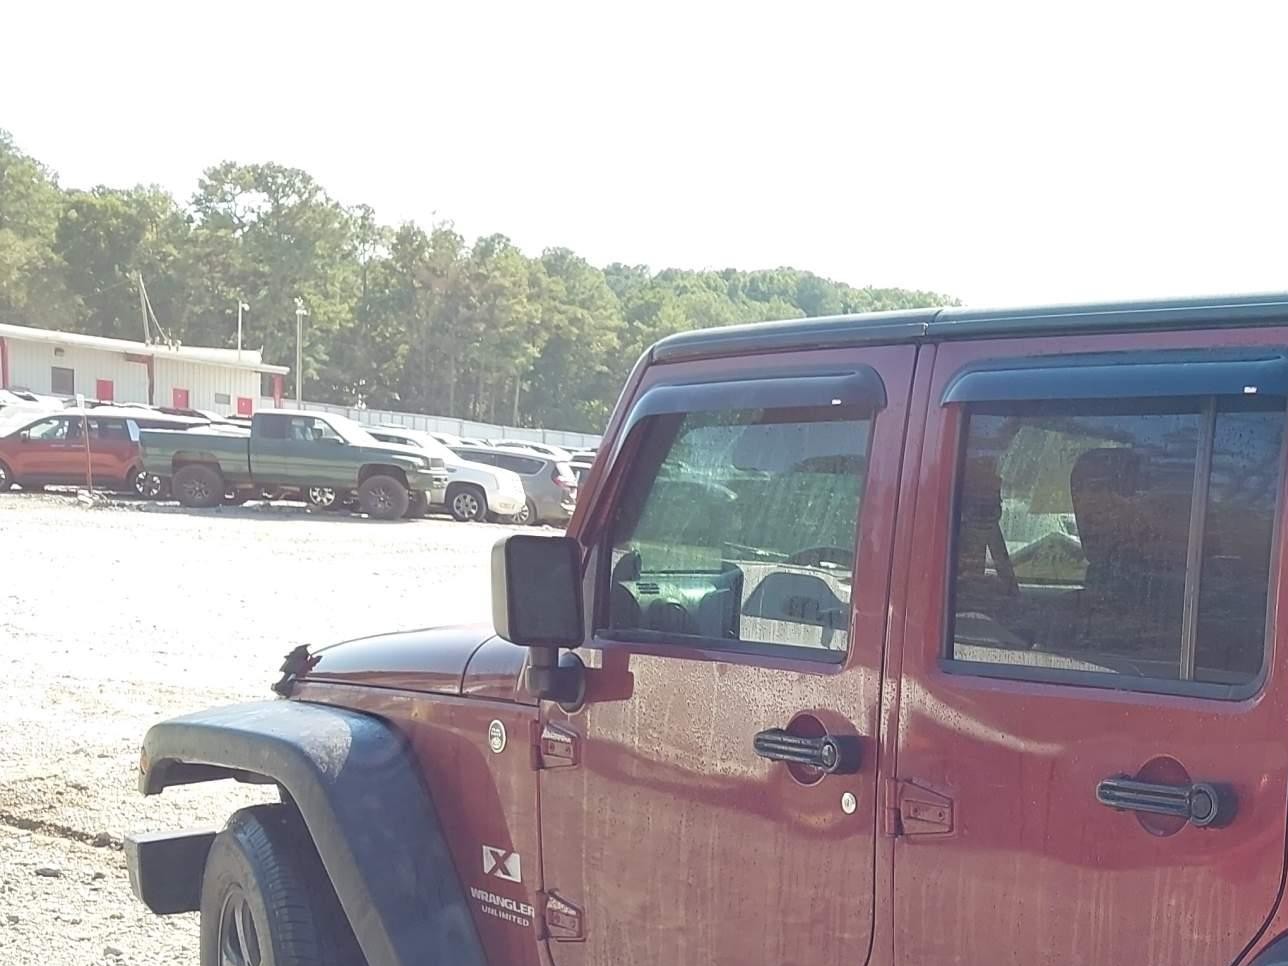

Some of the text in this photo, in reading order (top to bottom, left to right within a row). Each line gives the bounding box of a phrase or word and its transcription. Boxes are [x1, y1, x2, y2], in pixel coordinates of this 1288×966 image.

[482, 845, 521, 883] X
[470, 887, 535, 918] WRANGLER
[482, 905, 530, 927] UNLIMITED
